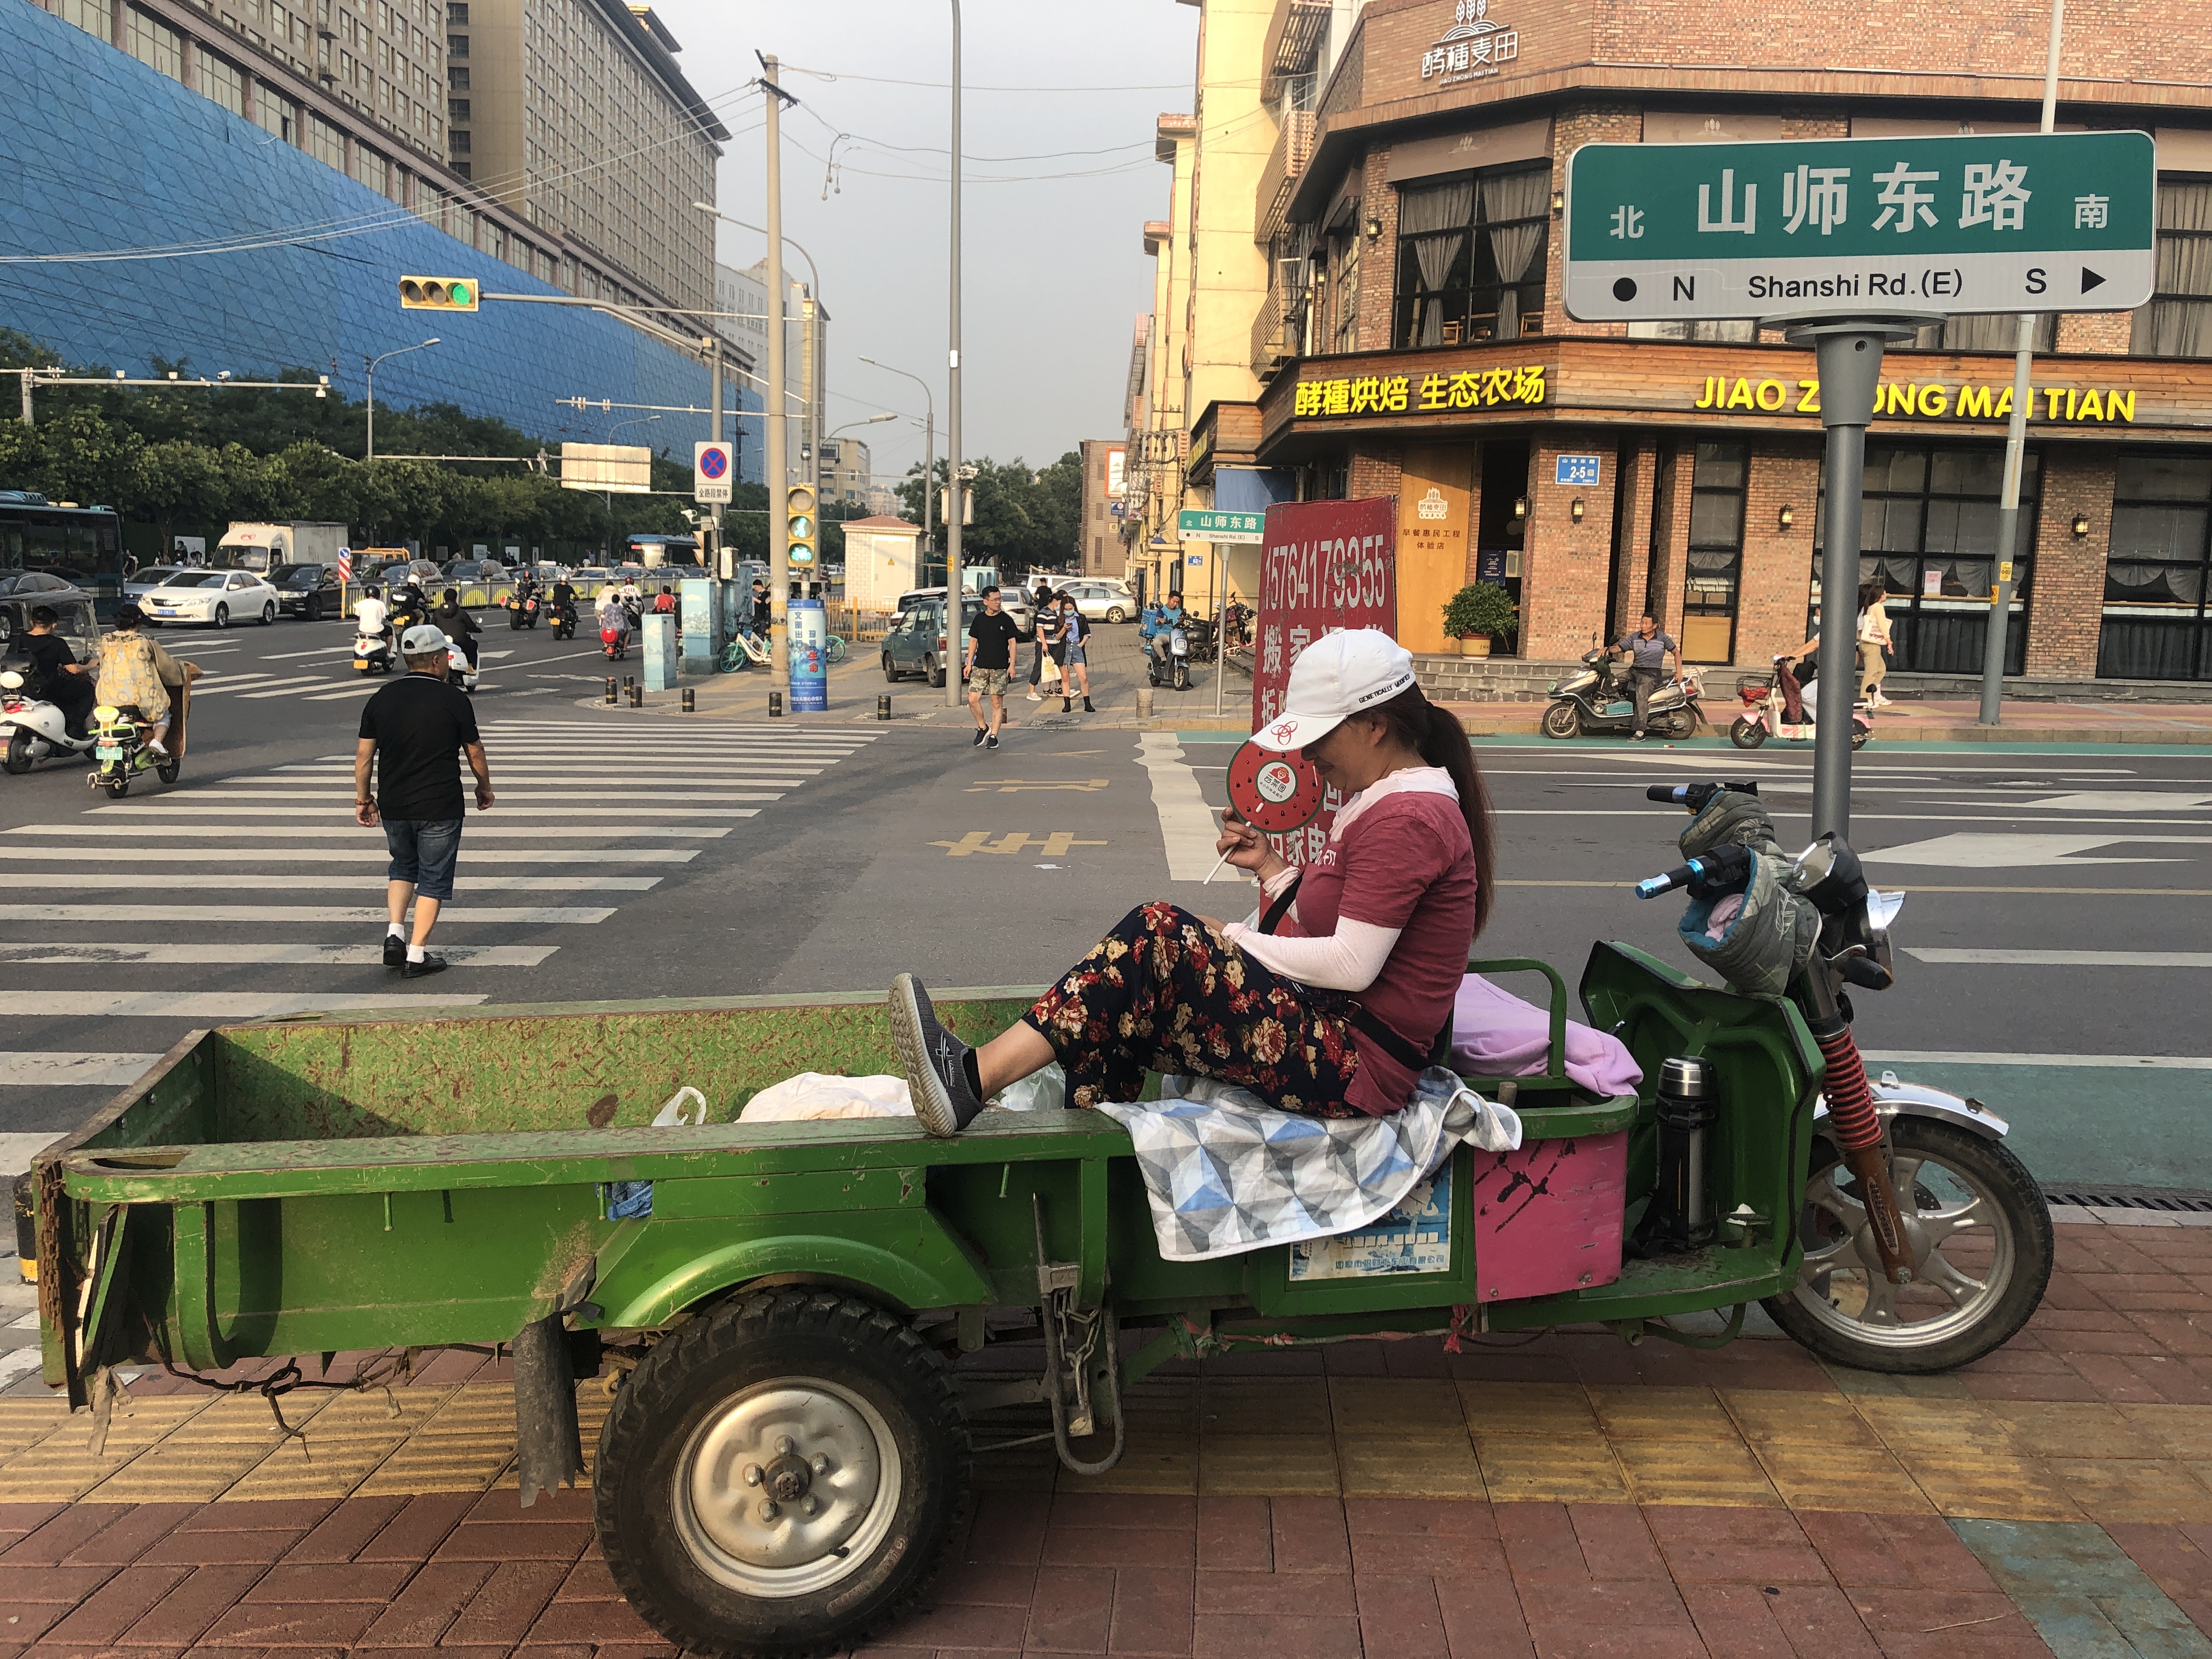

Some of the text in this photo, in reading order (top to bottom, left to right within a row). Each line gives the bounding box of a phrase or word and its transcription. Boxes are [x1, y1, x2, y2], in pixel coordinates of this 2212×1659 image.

[1439, 77, 1452, 86] JIAO
[1453, 73, 1473, 82] ZHONG
[1485, 67, 1499, 76] TIAN
[1610, 159, 2110, 240] 北 山师东路 南
[1673, 275, 1695, 301] N
[1748, 274, 1859, 298] Shanshi
[2025, 268, 2047, 295] S
[1294, 365, 1546, 416] 酵種烘焙 生态农场
[1695, 376, 1786, 411] JIAO
[1796, 379, 1948, 417] ZNG
[2043, 387, 2136, 422] TIAN
[699, 488, 728, 498] 全路段禁停
[1200, 515, 1257, 530] 山师东路
[1403, 528, 1460, 538] 早餐惠民工程
[1417, 541, 1445, 550] 体验店
[1265, 534, 1386, 611] 15764179355
[794, 611, 803, 647] 文明出行
[1358, 684, 1393, 703] GENETICALLY
